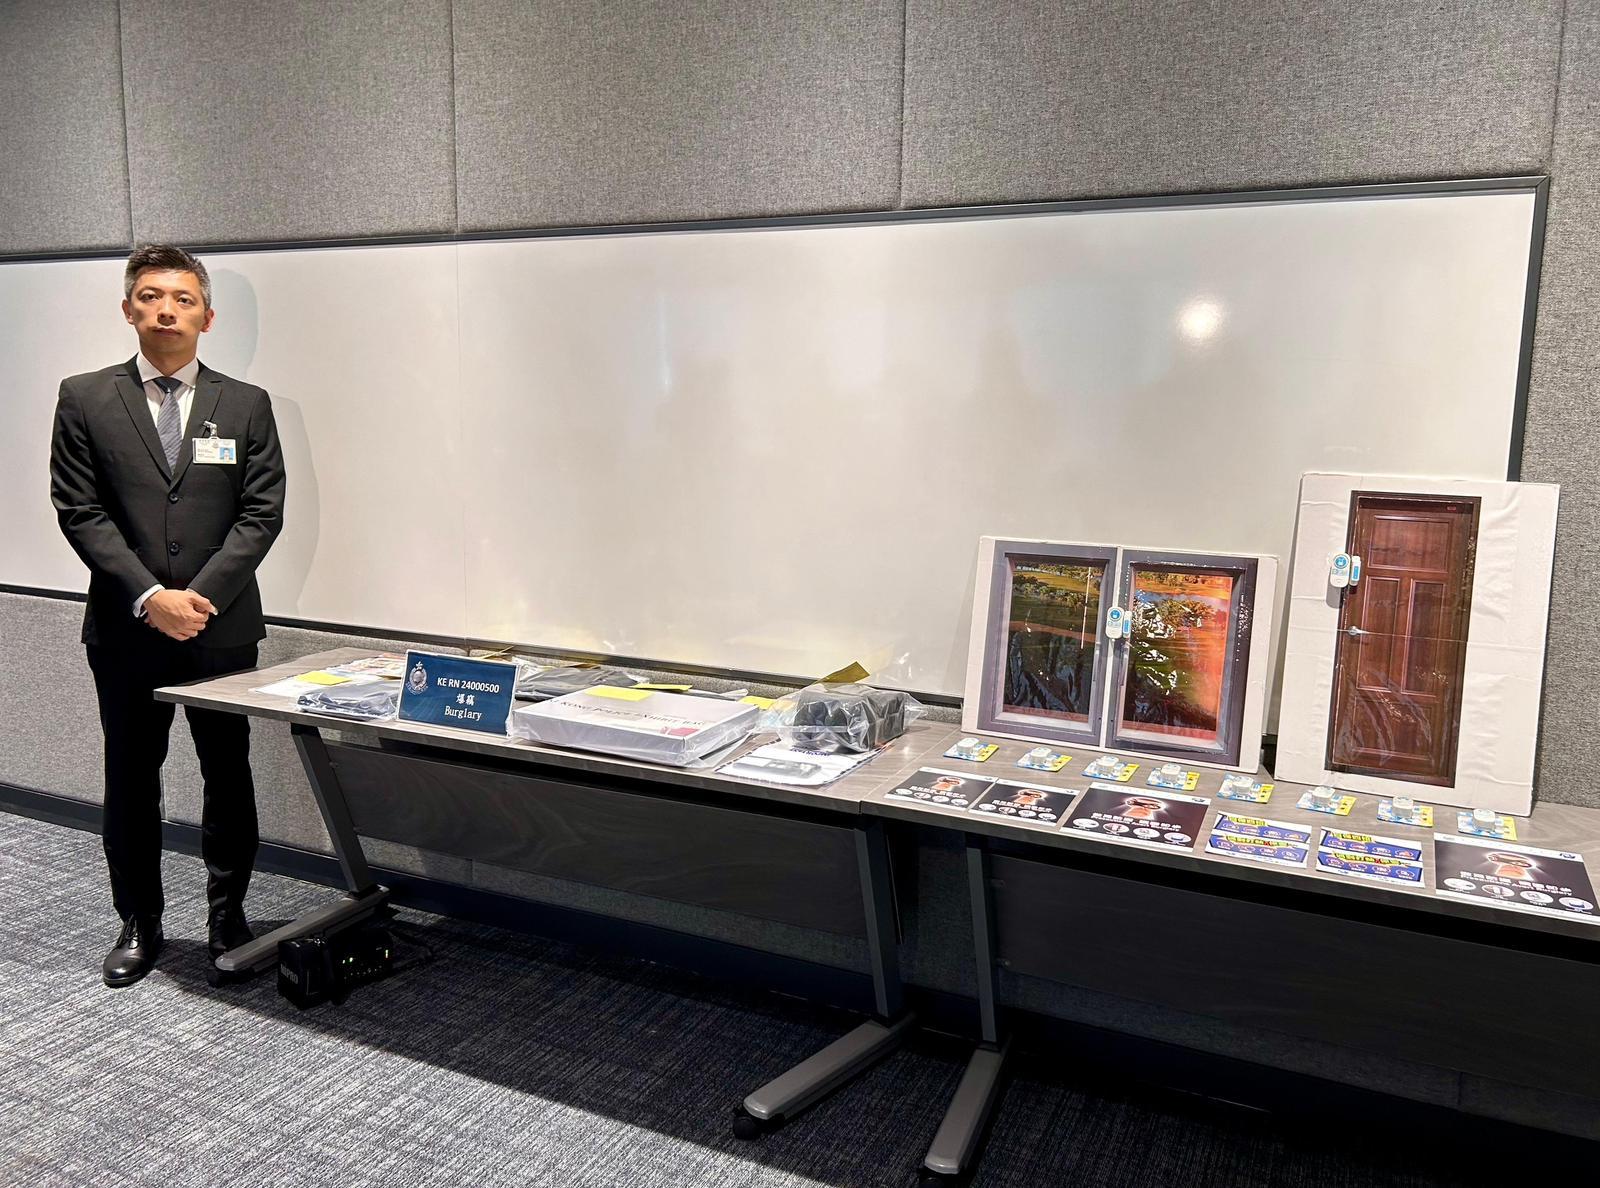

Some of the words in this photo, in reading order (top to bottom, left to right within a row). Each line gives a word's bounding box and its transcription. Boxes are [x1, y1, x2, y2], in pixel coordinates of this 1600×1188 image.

[437, 677, 447, 687] KE
[448, 679, 460, 688] RN
[461, 680, 500, 693] 24000500
[444, 705, 482, 721] Burglary
